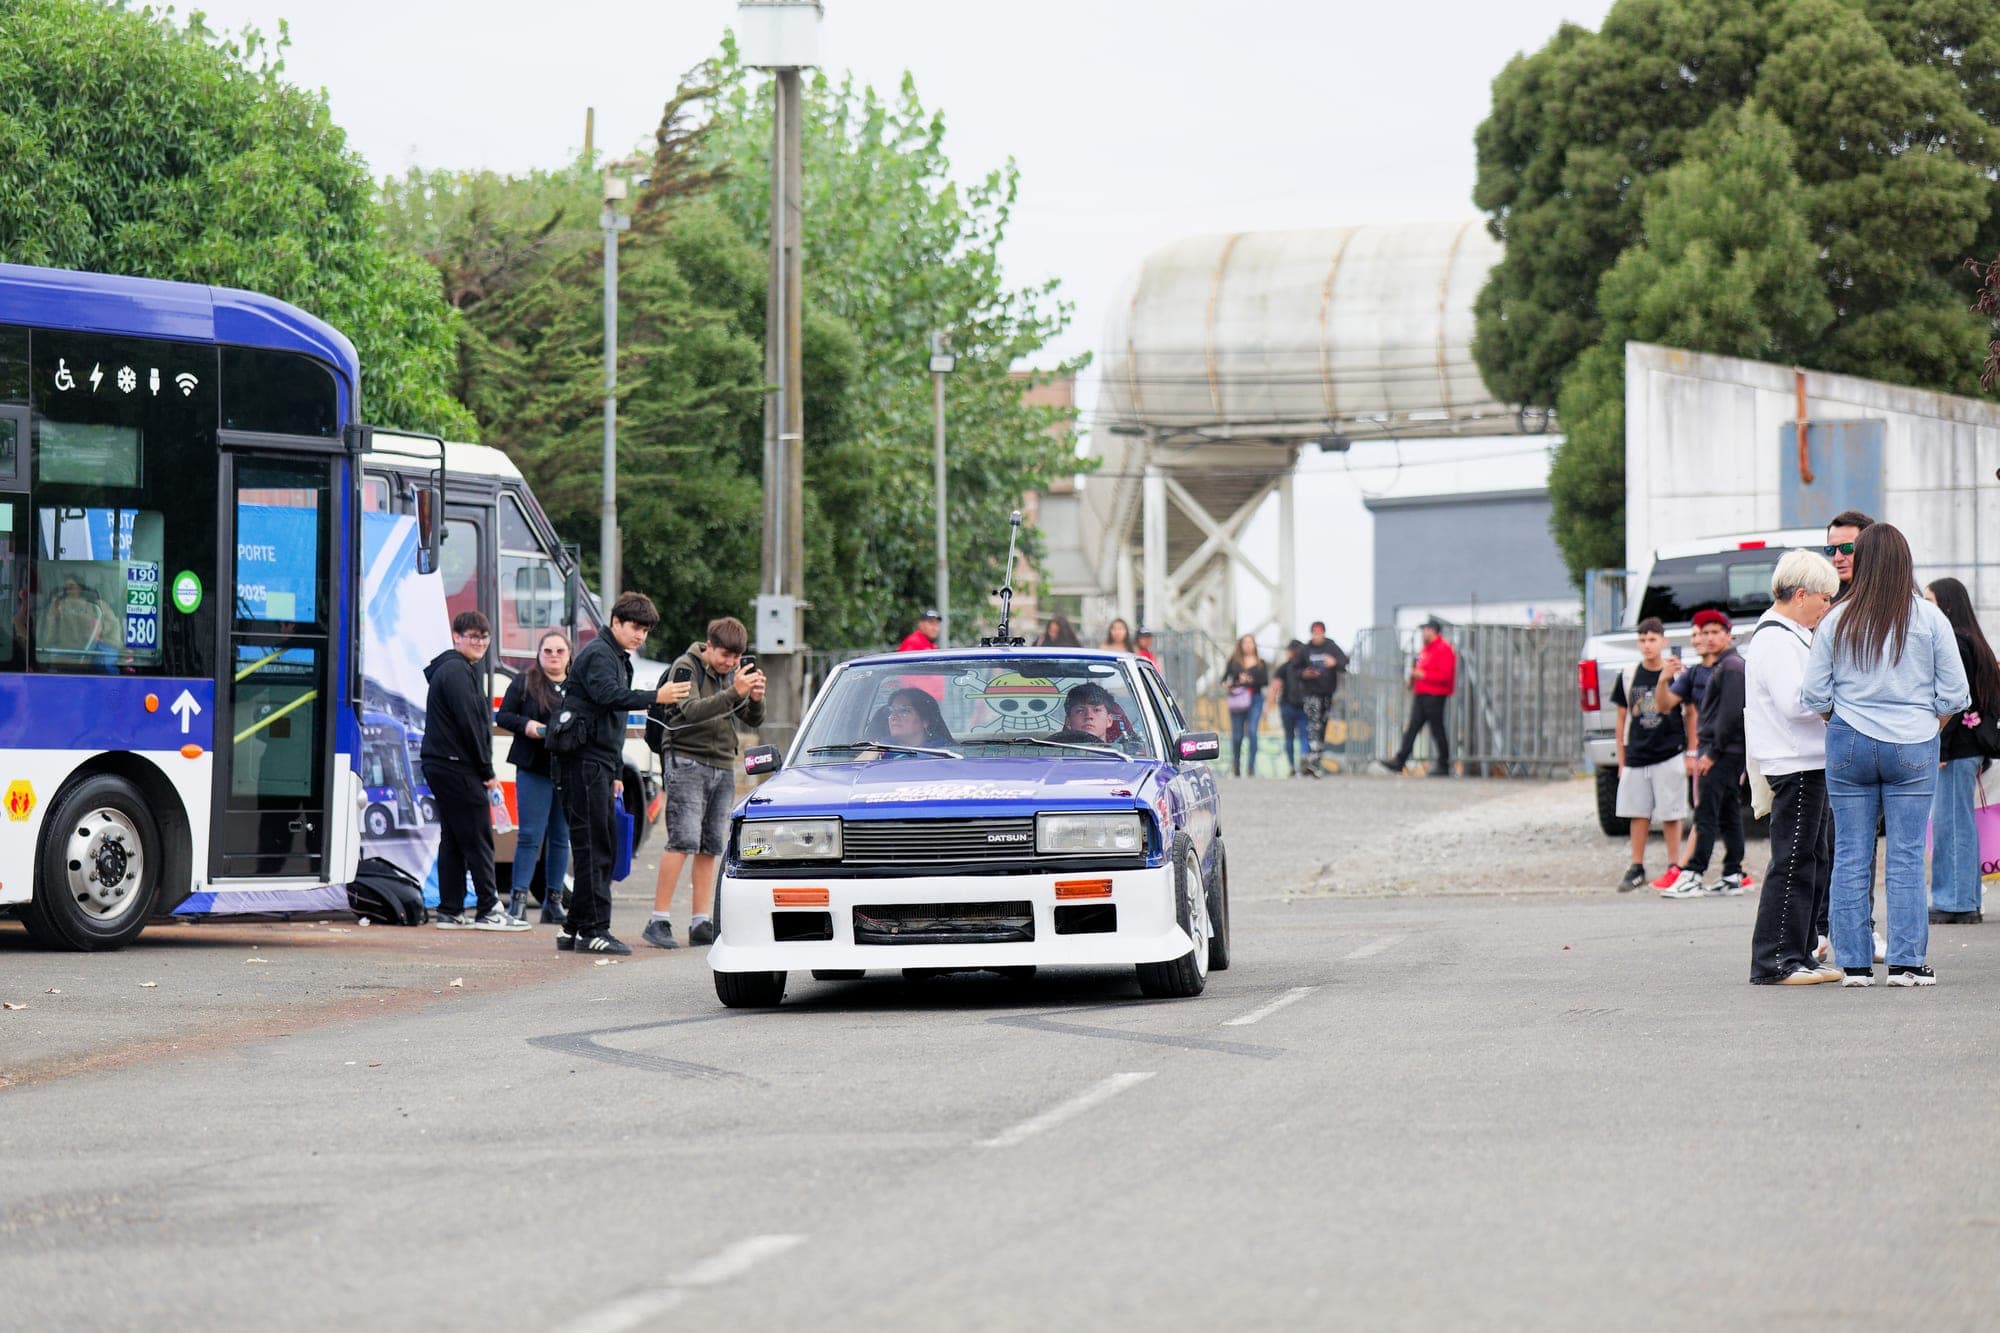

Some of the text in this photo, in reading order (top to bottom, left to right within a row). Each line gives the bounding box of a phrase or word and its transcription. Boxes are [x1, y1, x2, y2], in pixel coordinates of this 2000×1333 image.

[238, 544, 276, 562] PORTE
[132, 569, 156, 582] 190
[130, 591, 155, 605] 290
[127, 618, 156, 644] 580
[988, 834, 1027, 842] DATSUN
